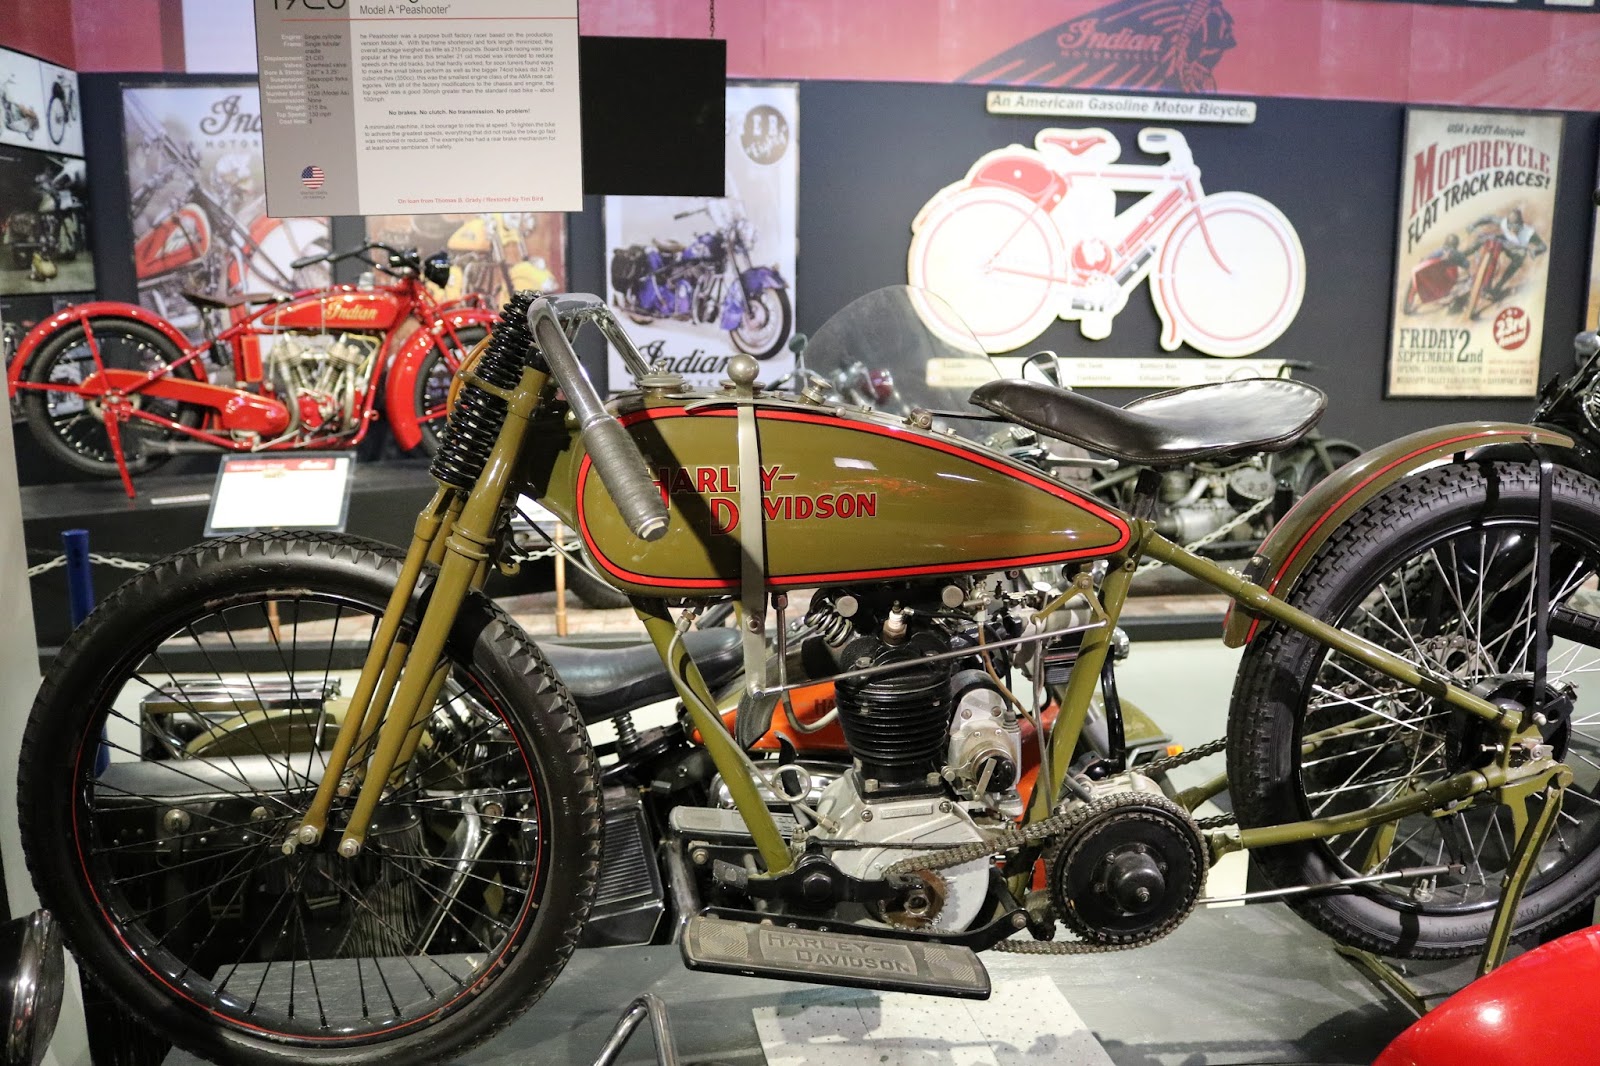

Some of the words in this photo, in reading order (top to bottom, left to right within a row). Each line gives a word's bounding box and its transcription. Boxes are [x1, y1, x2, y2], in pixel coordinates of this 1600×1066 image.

[360, 5, 386, 15] Model
[387, 5, 394, 14] A
[396, 4, 451, 14] "Peashooter"
[1057, 18, 1164, 51] Indian
[505, 108, 531, 116] problem!
[991, 95, 1012, 107] An
[1016, 96, 1083, 110] American
[1089, 98, 1148, 113] Gasoline
[1153, 101, 1195, 115] Motor
[1198, 103, 1251, 118] Bicycle.
[1471, 124, 1493, 135] BEST
[1494, 126, 1525, 138] Antique
[1410, 140, 1550, 219] MOTORCYCLE
[1408, 198, 1440, 253] FLAT
[1444, 171, 1490, 212] TRACK
[1493, 171, 1551, 190] RACES!
[325, 301, 378, 320] Indian
[1398, 350, 1454, 363] SEPTEMBER
[1399, 327, 1459, 349] FRIDAY
[1457, 330, 1484, 363] 2nd
[648, 465, 798, 510] HARLY-
[710, 492, 877, 536] DVIDSON
[768, 933, 884, 955] HARLEY-
[795, 949, 911, 973] DAVIDSON
